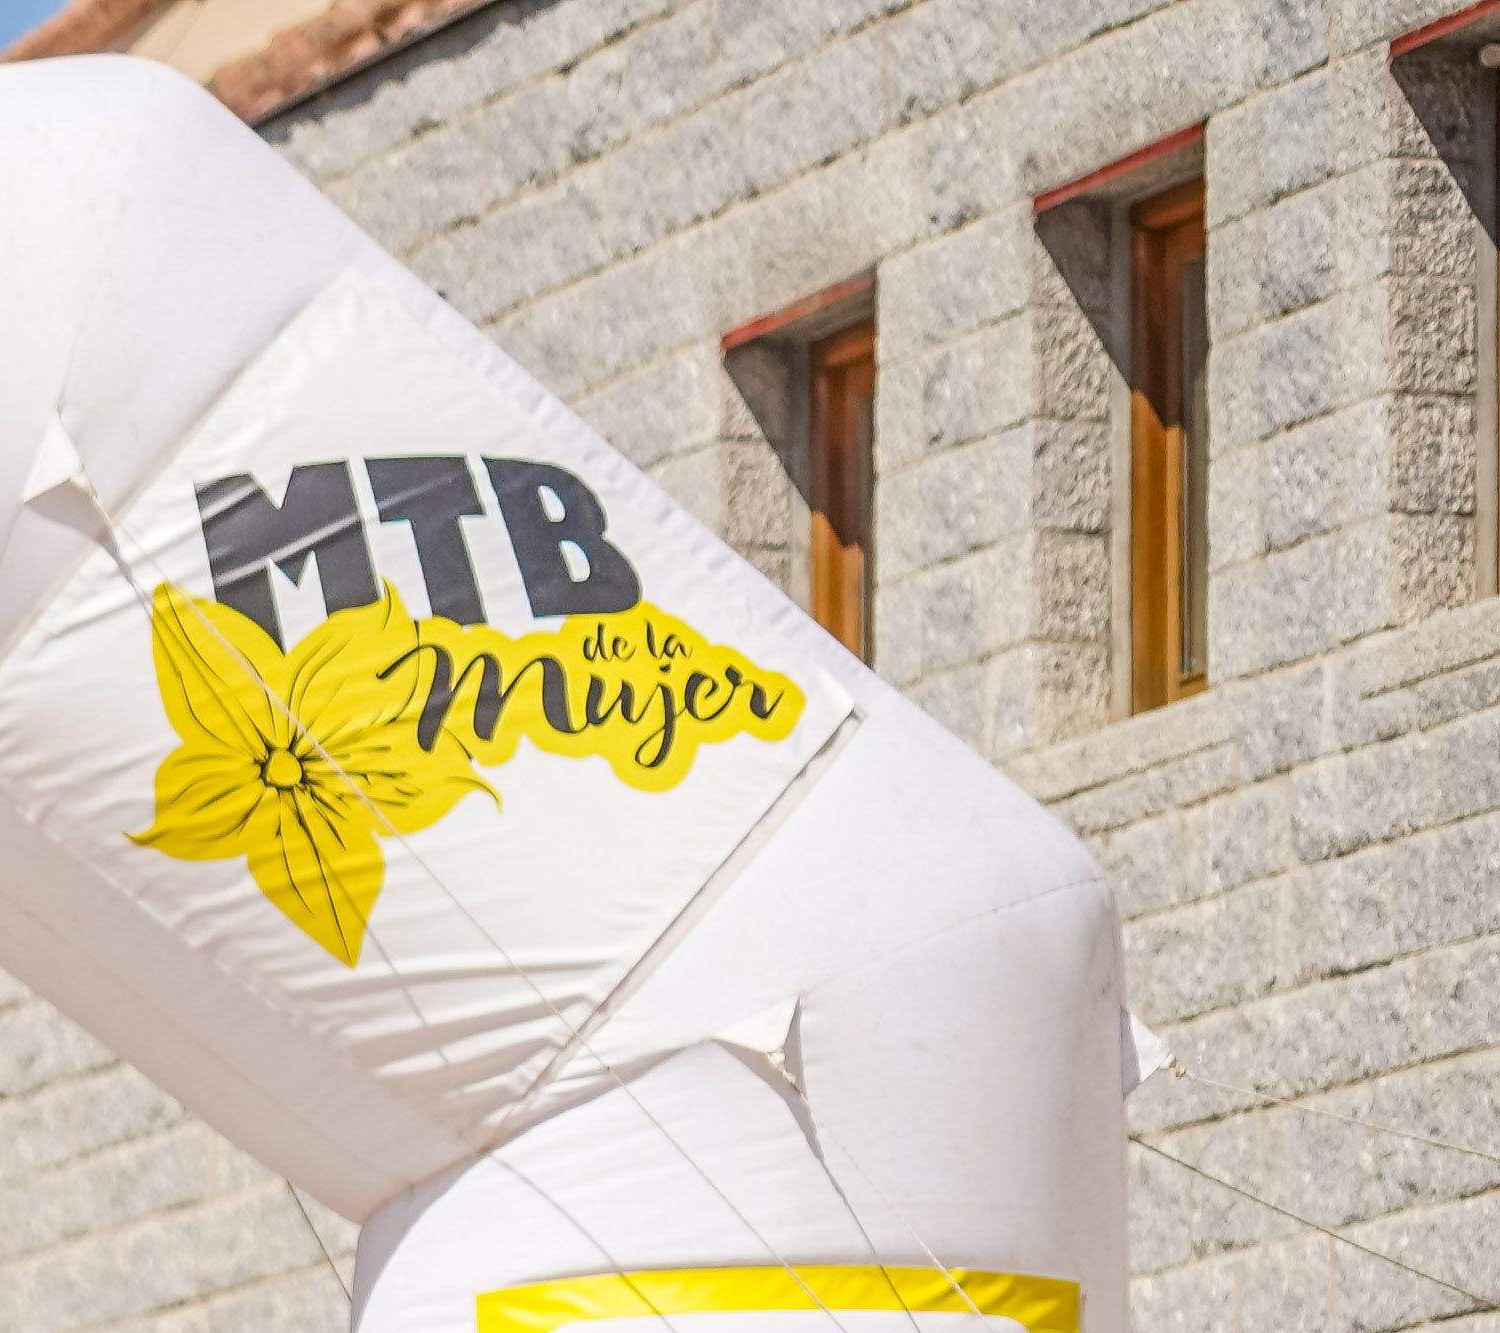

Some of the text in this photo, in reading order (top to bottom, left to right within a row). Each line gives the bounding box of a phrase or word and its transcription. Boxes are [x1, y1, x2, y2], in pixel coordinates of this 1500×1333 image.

[192, 454, 643, 653] MTB
[377, 640, 784, 769] Mujer
[583, 620, 688, 662] de la
